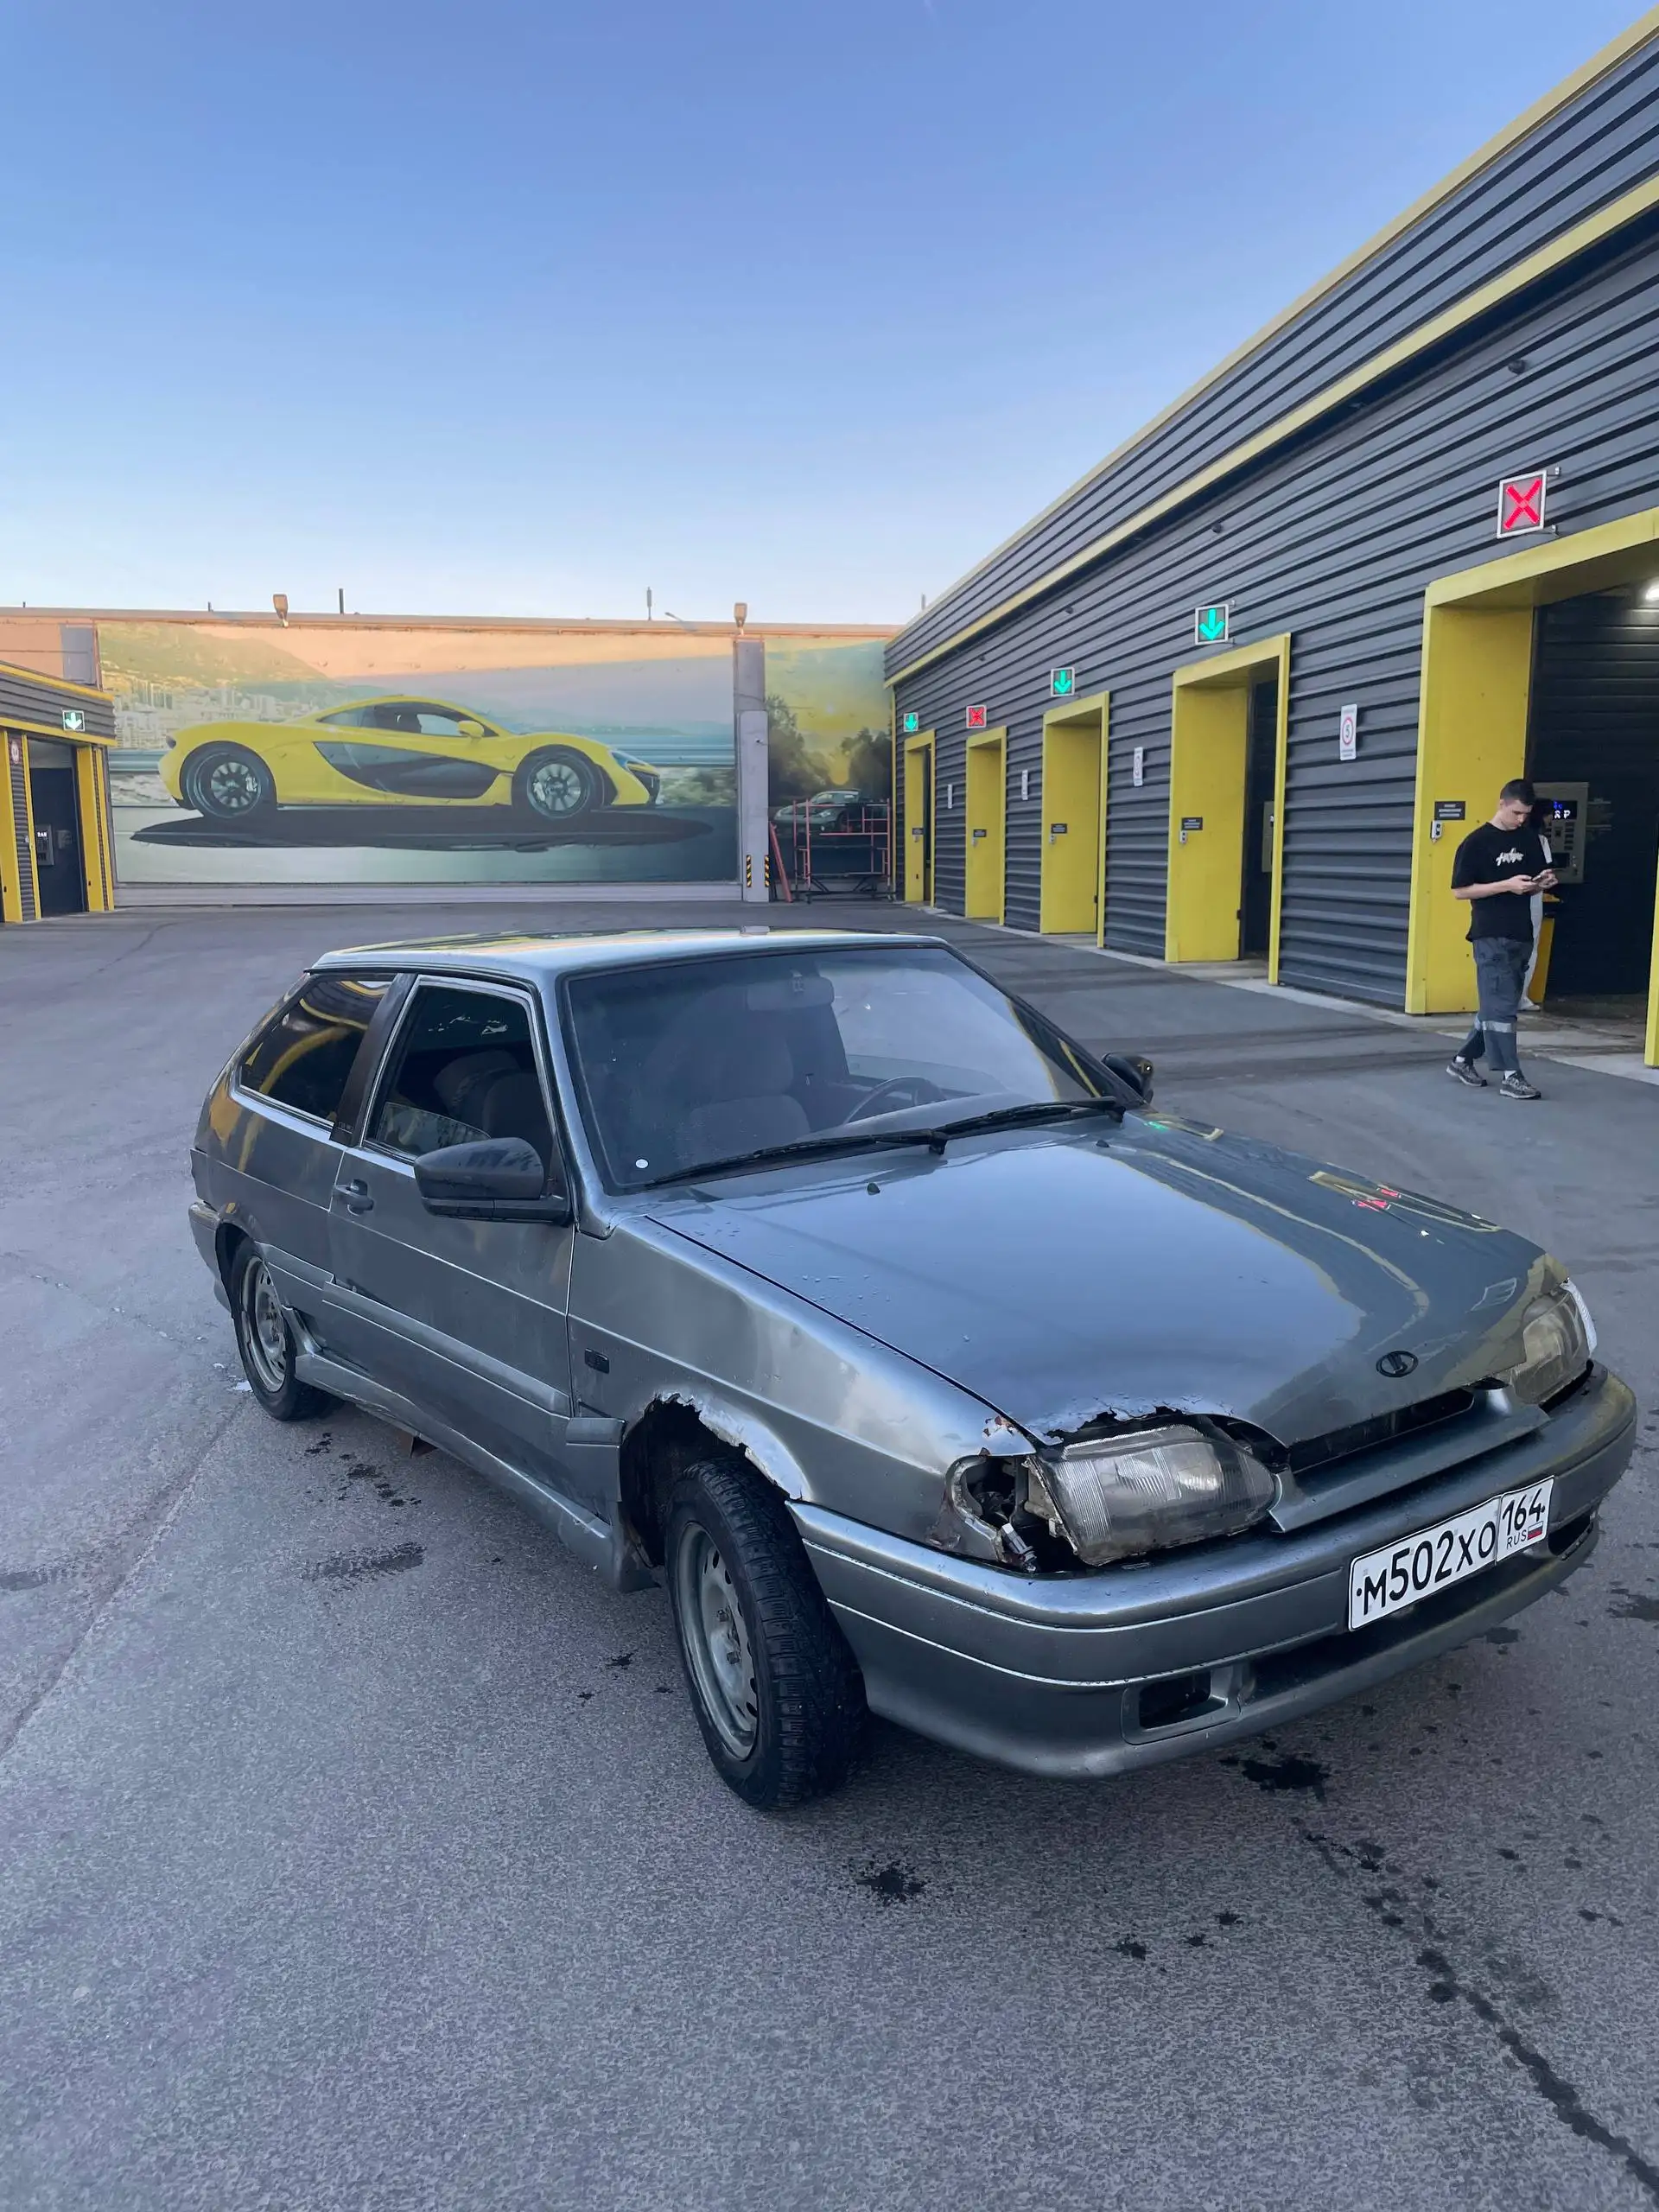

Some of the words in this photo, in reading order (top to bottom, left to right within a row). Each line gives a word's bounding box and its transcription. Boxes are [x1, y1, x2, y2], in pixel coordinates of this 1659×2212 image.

[1363, 1521, 1497, 1616] М502ХО
[1502, 1488, 1542, 1536] 164
[1506, 1529, 1528, 1549] RUS
